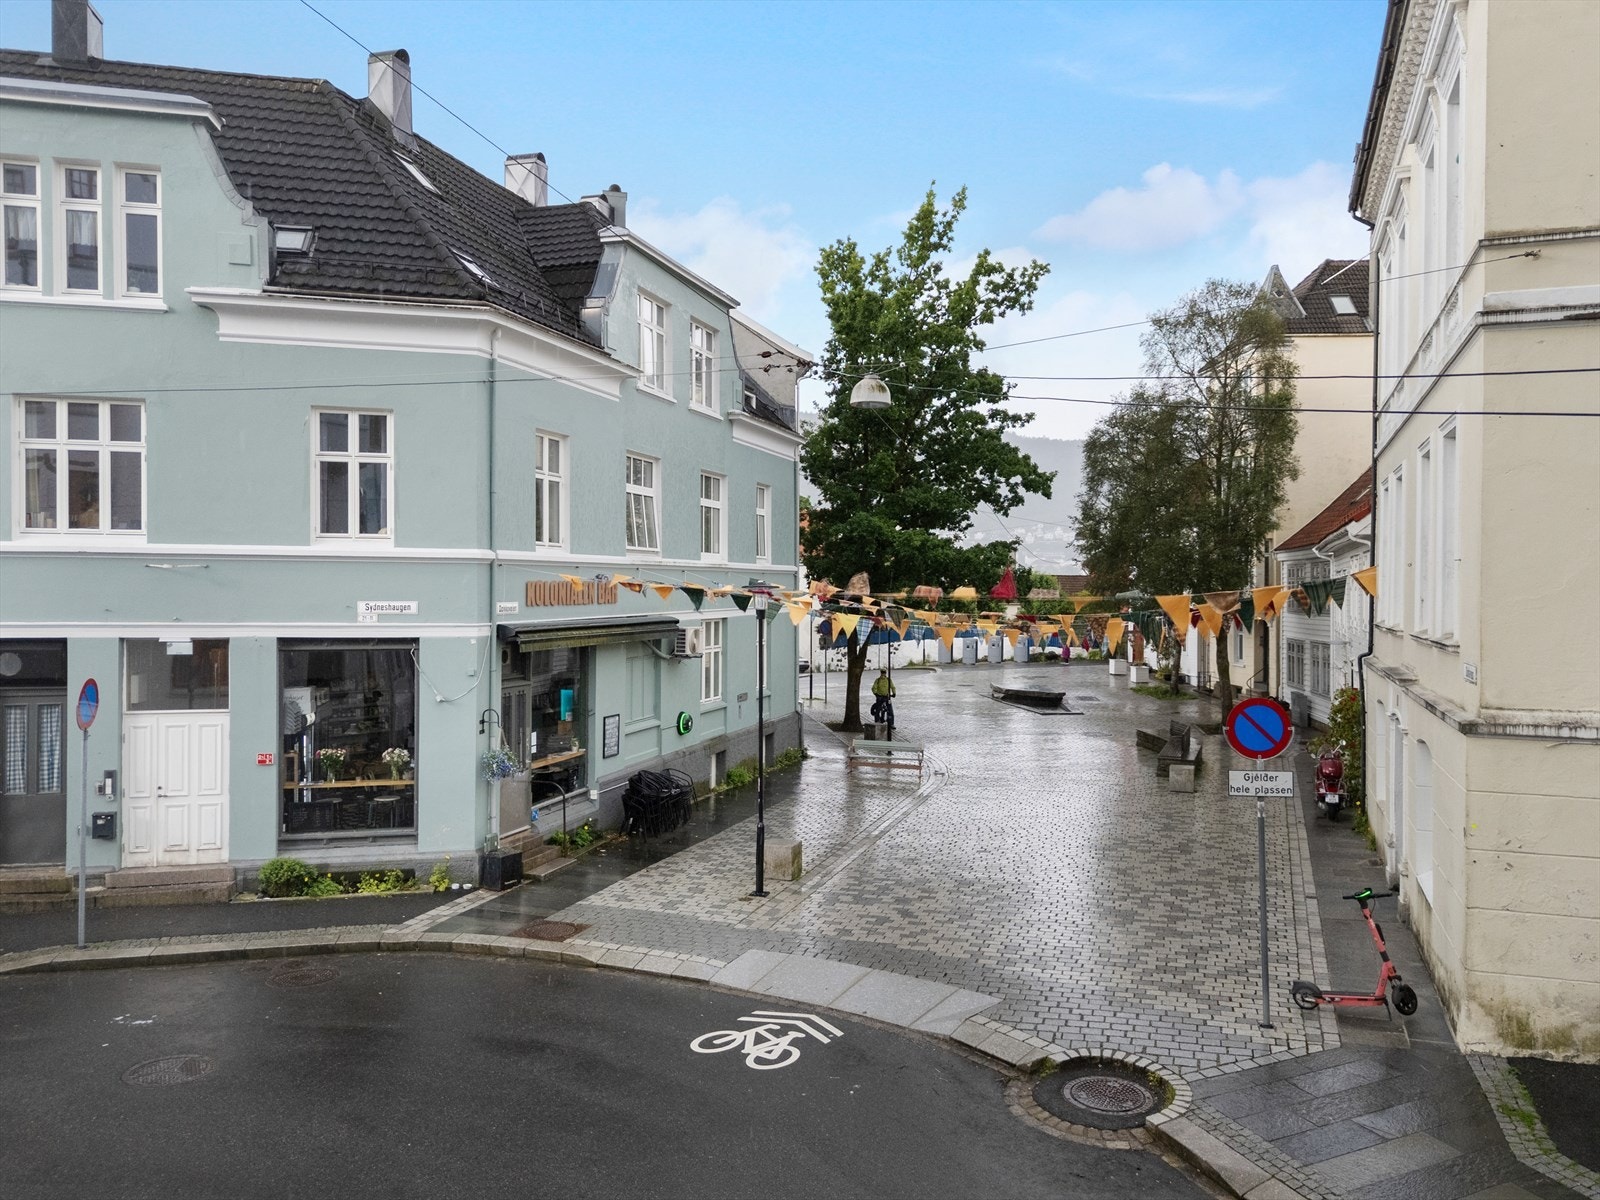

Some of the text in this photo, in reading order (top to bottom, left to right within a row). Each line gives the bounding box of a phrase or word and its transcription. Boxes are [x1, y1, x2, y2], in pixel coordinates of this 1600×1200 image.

[526, 581, 618, 607] KOLONIALEN BAR
[364, 602, 412, 613] Sydneshaugen
[1244, 773, 1279, 783] Gjelder
[1230, 785, 1293, 795] hele plassen
